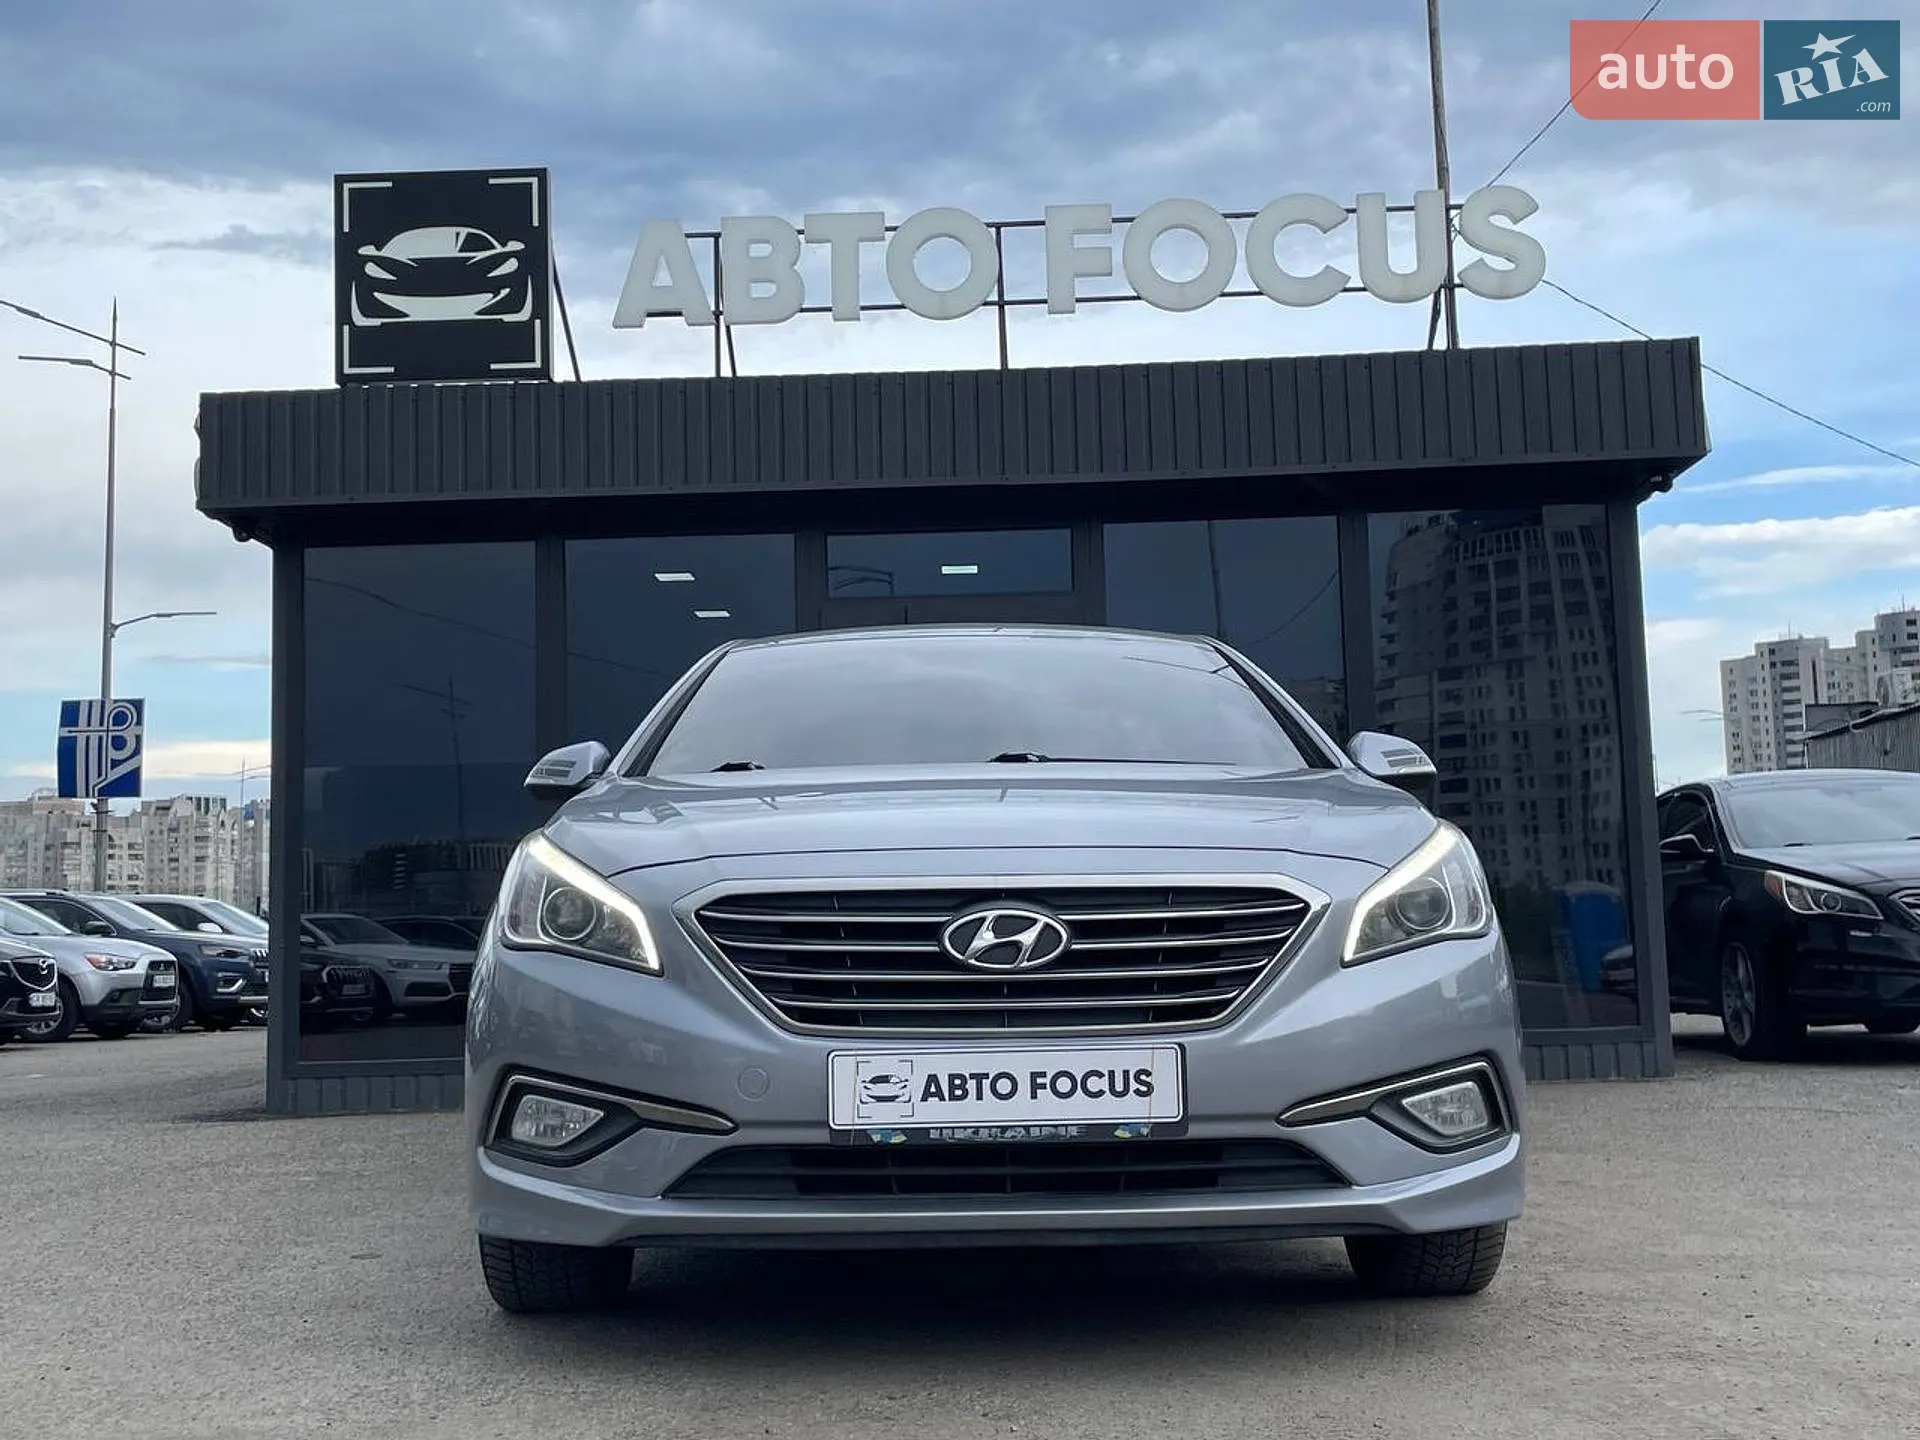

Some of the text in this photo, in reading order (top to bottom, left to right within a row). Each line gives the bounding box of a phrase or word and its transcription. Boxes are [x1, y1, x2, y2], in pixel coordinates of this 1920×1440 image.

[613, 184, 1546, 329] АВТО FOCUS
[919, 1068, 1154, 1103] АВТО FOCUS
